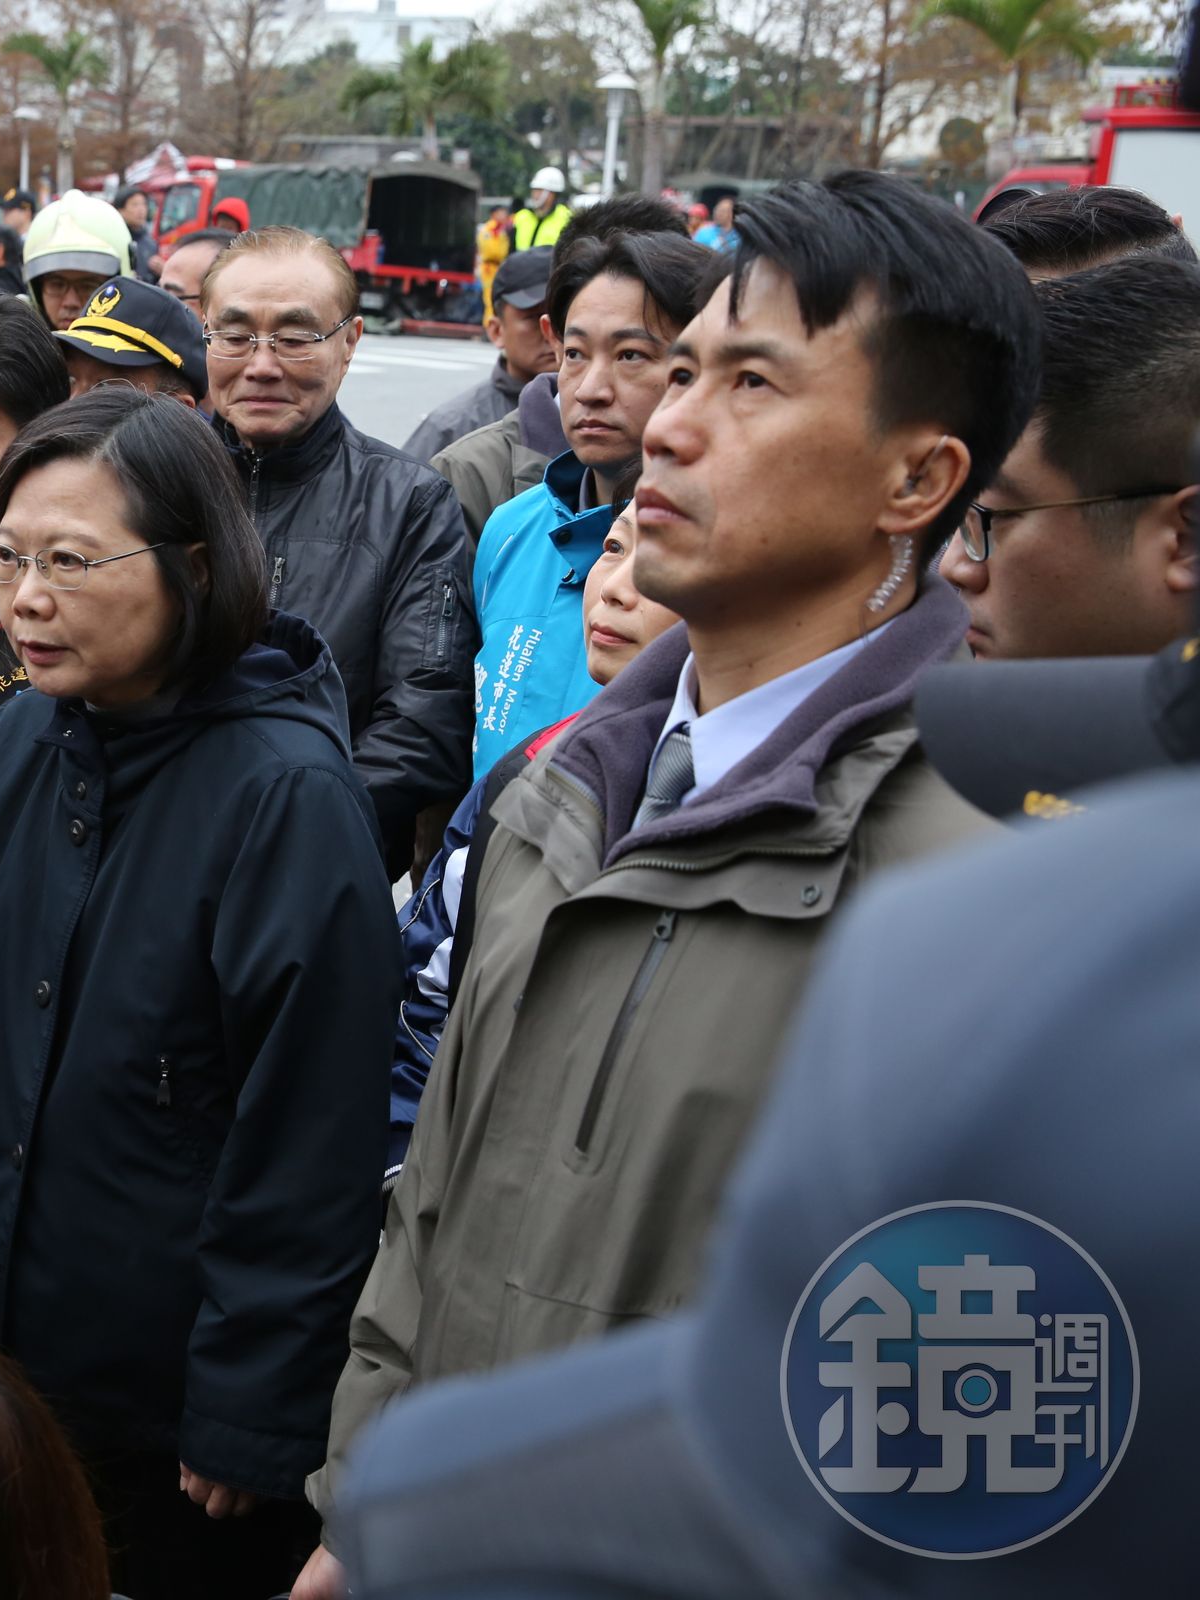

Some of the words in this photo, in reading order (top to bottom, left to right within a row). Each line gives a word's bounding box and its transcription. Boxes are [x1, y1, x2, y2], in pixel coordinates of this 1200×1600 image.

[482, 624, 524, 731] 花蓮市長
[512, 628, 543, 682] Hualien
[497, 688, 518, 735] Mayor
